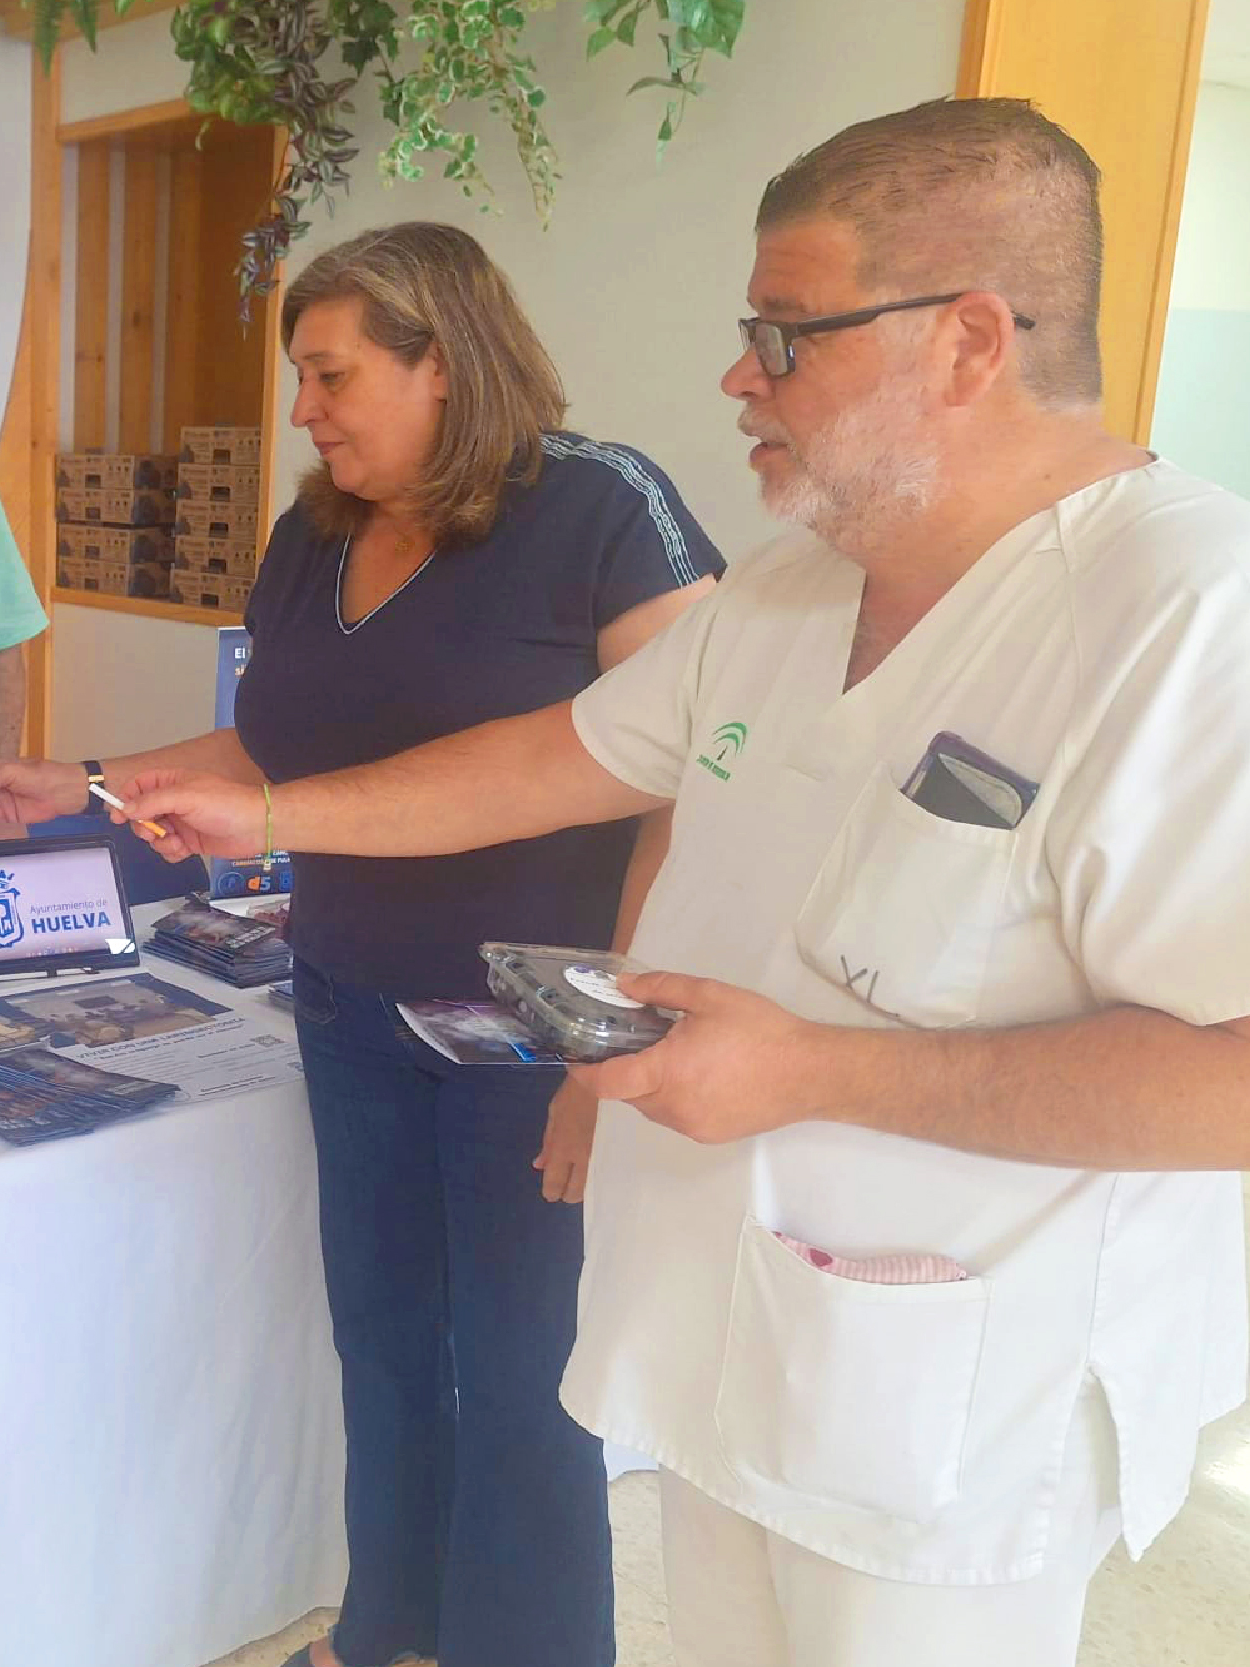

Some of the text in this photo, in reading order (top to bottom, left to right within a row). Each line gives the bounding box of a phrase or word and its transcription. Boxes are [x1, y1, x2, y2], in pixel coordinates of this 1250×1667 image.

[30, 897, 108, 915] Ayuntamiento de
[30, 911, 111, 934] HUELVA
